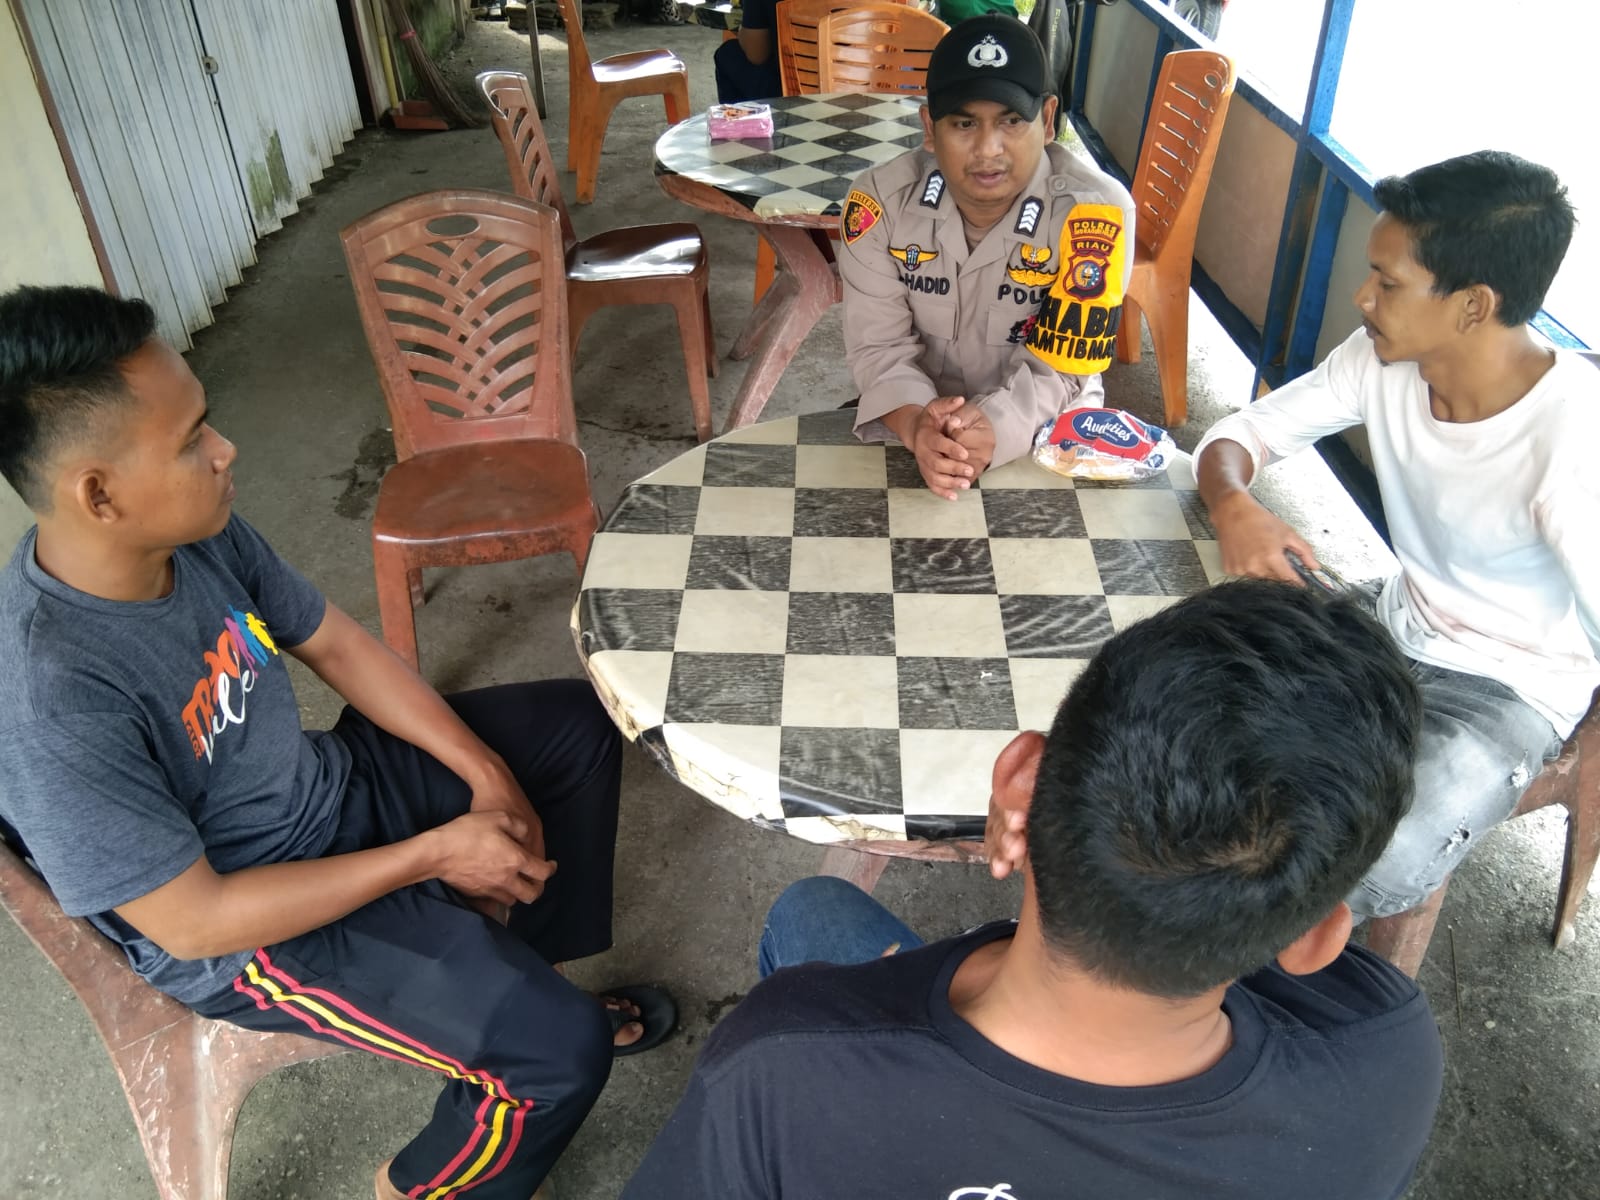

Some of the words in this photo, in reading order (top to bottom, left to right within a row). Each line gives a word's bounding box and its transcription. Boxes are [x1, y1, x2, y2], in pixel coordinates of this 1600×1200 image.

[1073, 221, 1117, 234] POLRES
[1076, 241, 1110, 252] RIAU
[900, 272, 951, 296] HADID
[999, 284, 1045, 306] POL
[1026, 325, 1117, 361] AMTIBMA
